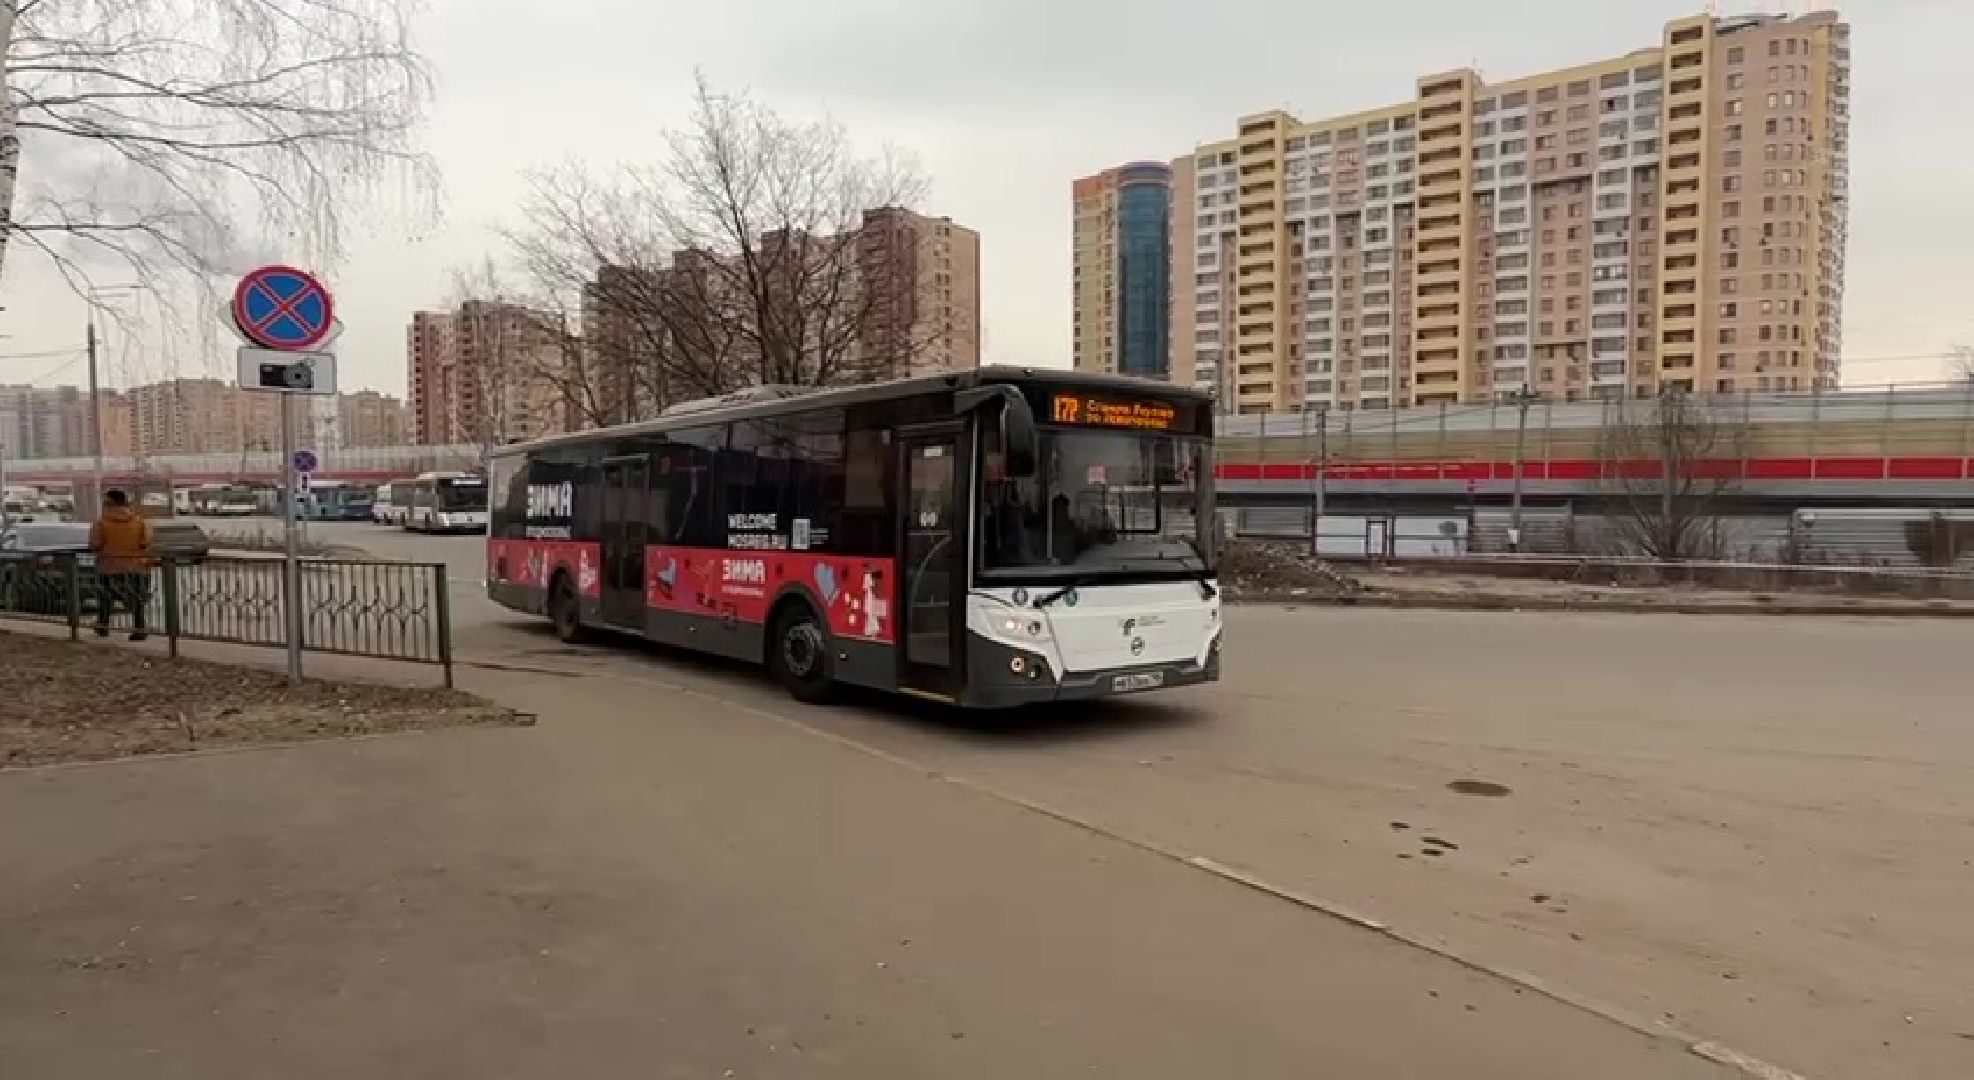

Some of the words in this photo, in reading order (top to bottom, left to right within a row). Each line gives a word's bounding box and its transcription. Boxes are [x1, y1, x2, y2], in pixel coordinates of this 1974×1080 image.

[526, 481, 573, 517] ЗИМА
[728, 513, 777, 530] WELCOME
[722, 558, 766, 584] ЗИМА
